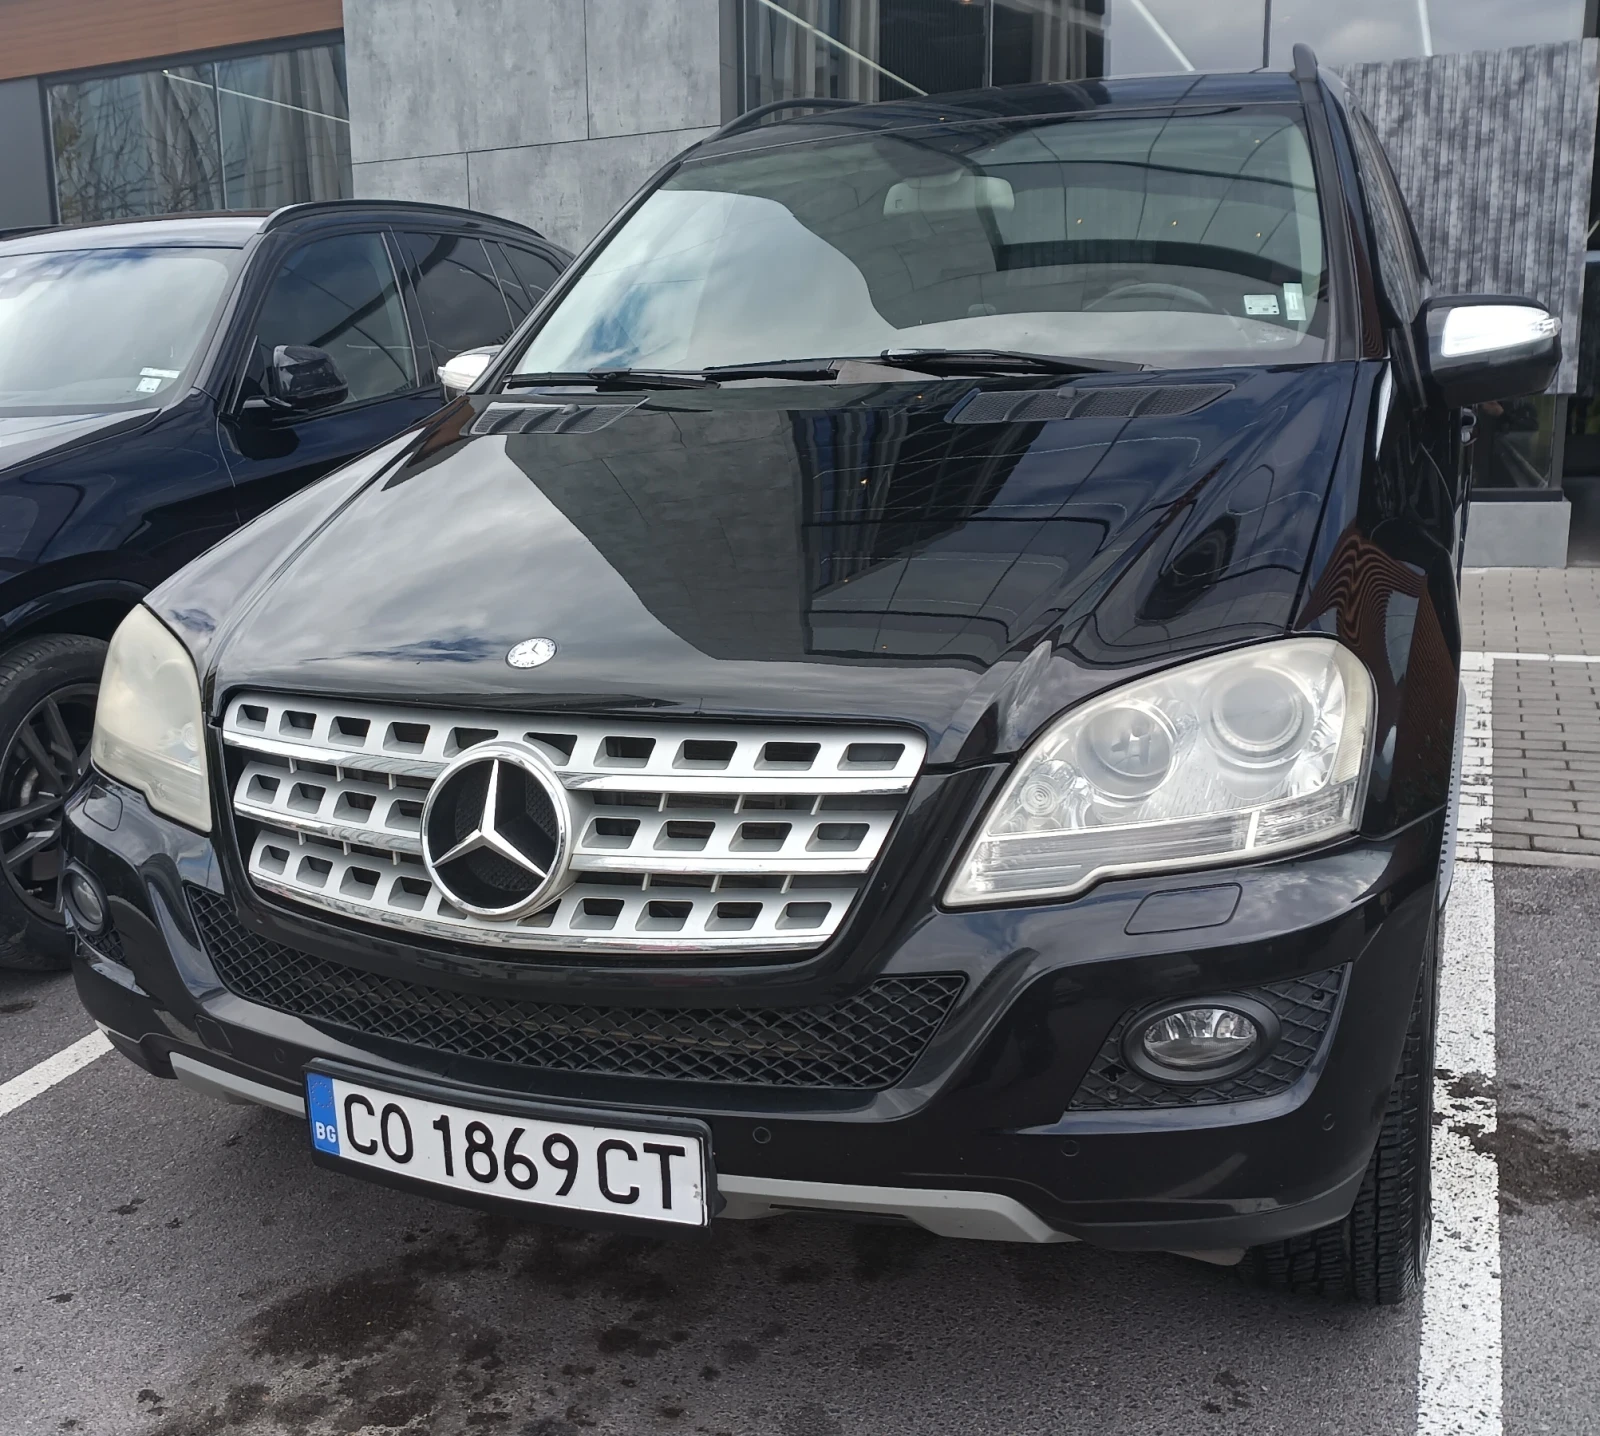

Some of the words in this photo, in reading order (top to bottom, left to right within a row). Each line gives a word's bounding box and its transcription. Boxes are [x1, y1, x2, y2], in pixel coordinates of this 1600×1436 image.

[316, 1121, 337, 1143] BG
[344, 1093, 413, 1164] CO
[433, 1114, 579, 1197] 1869
[597, 1139, 686, 1210] CT
